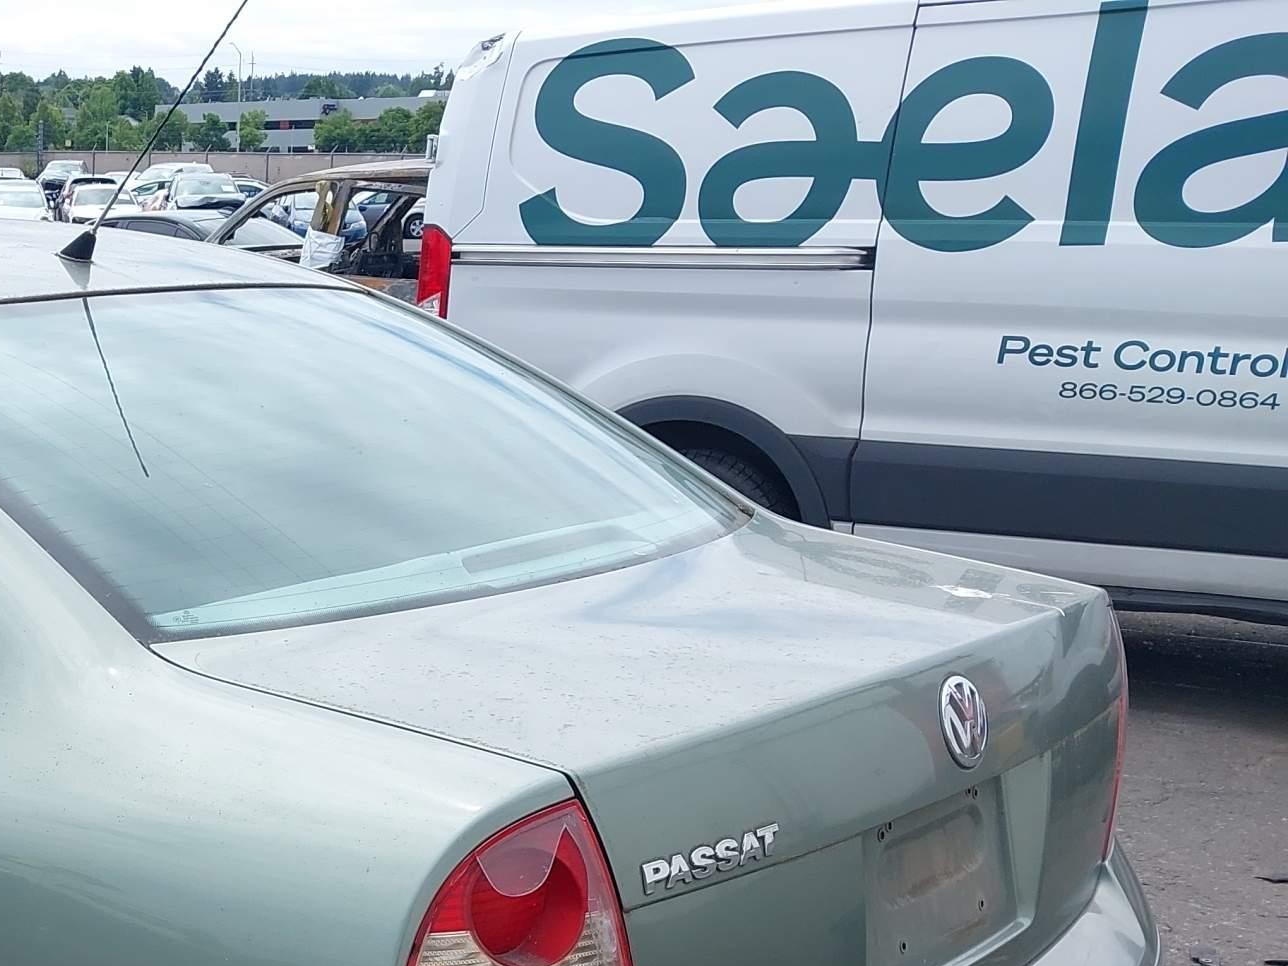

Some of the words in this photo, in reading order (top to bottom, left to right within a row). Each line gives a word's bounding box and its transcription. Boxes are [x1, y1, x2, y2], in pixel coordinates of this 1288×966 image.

[997, 335, 1102, 369] Pest
[1058, 381, 1280, 411] 866-529-0864
[641, 823, 779, 895] PASSAT
